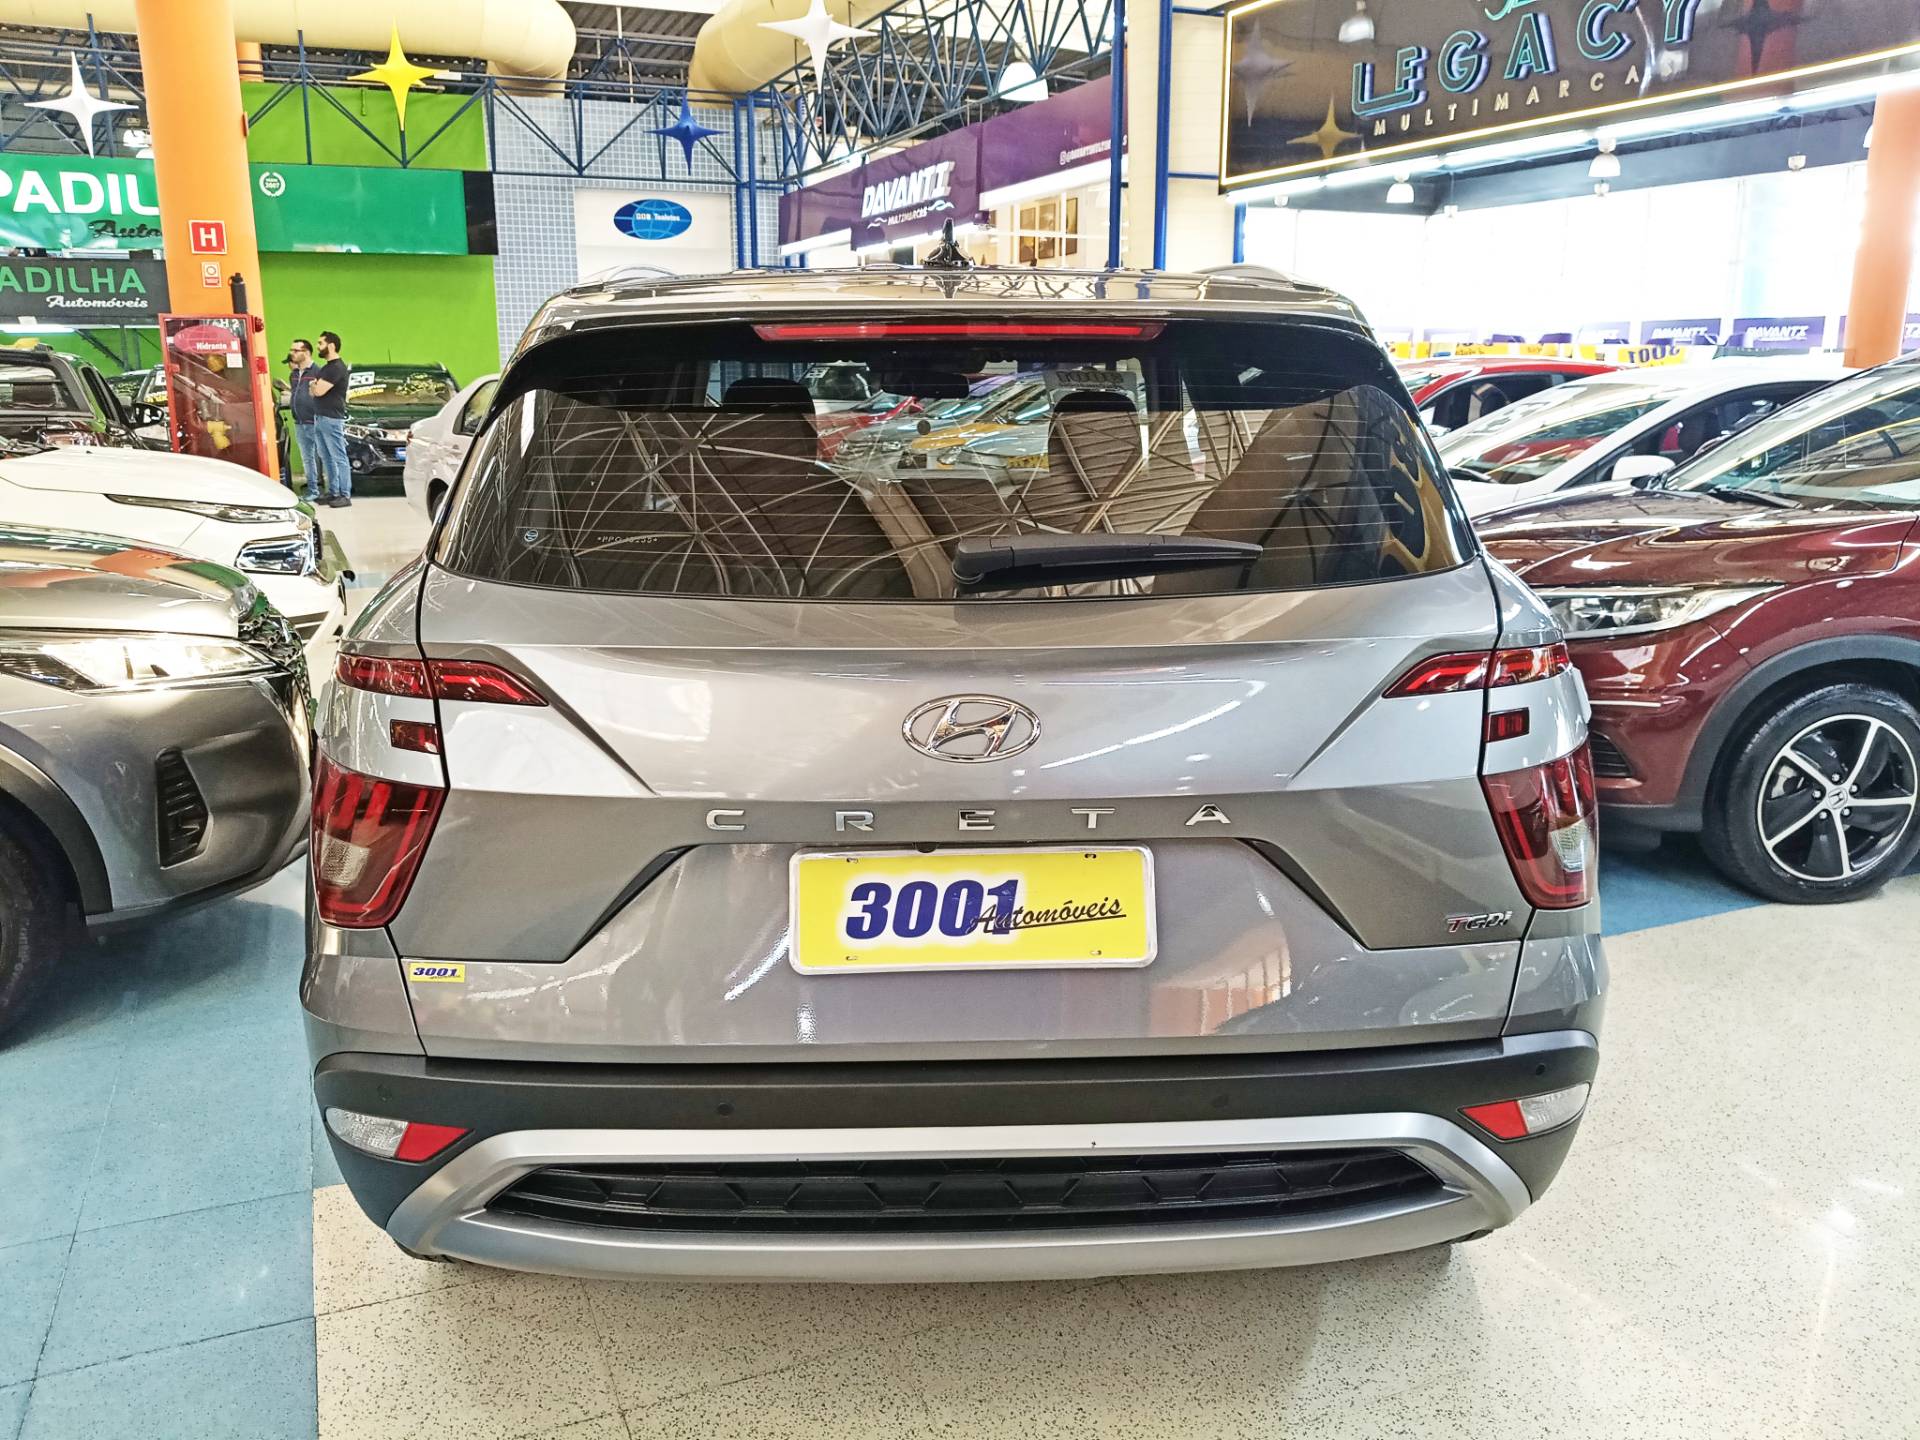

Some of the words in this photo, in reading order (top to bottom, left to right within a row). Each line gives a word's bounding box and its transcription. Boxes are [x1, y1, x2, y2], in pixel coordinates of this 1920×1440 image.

[1352, 0, 1697, 117] LEGACY
[862, 161, 955, 218] DAVANTI
[199, 227, 217, 247] H
[46, 295, 148, 309] Automóveis
[196, 341, 227, 350] Hidrante
[706, 804, 1231, 832] CRETA
[845, 879, 1018, 941] 3001
[966, 895, 1126, 934] Automóveis
[413, 967, 457, 977] 3001
